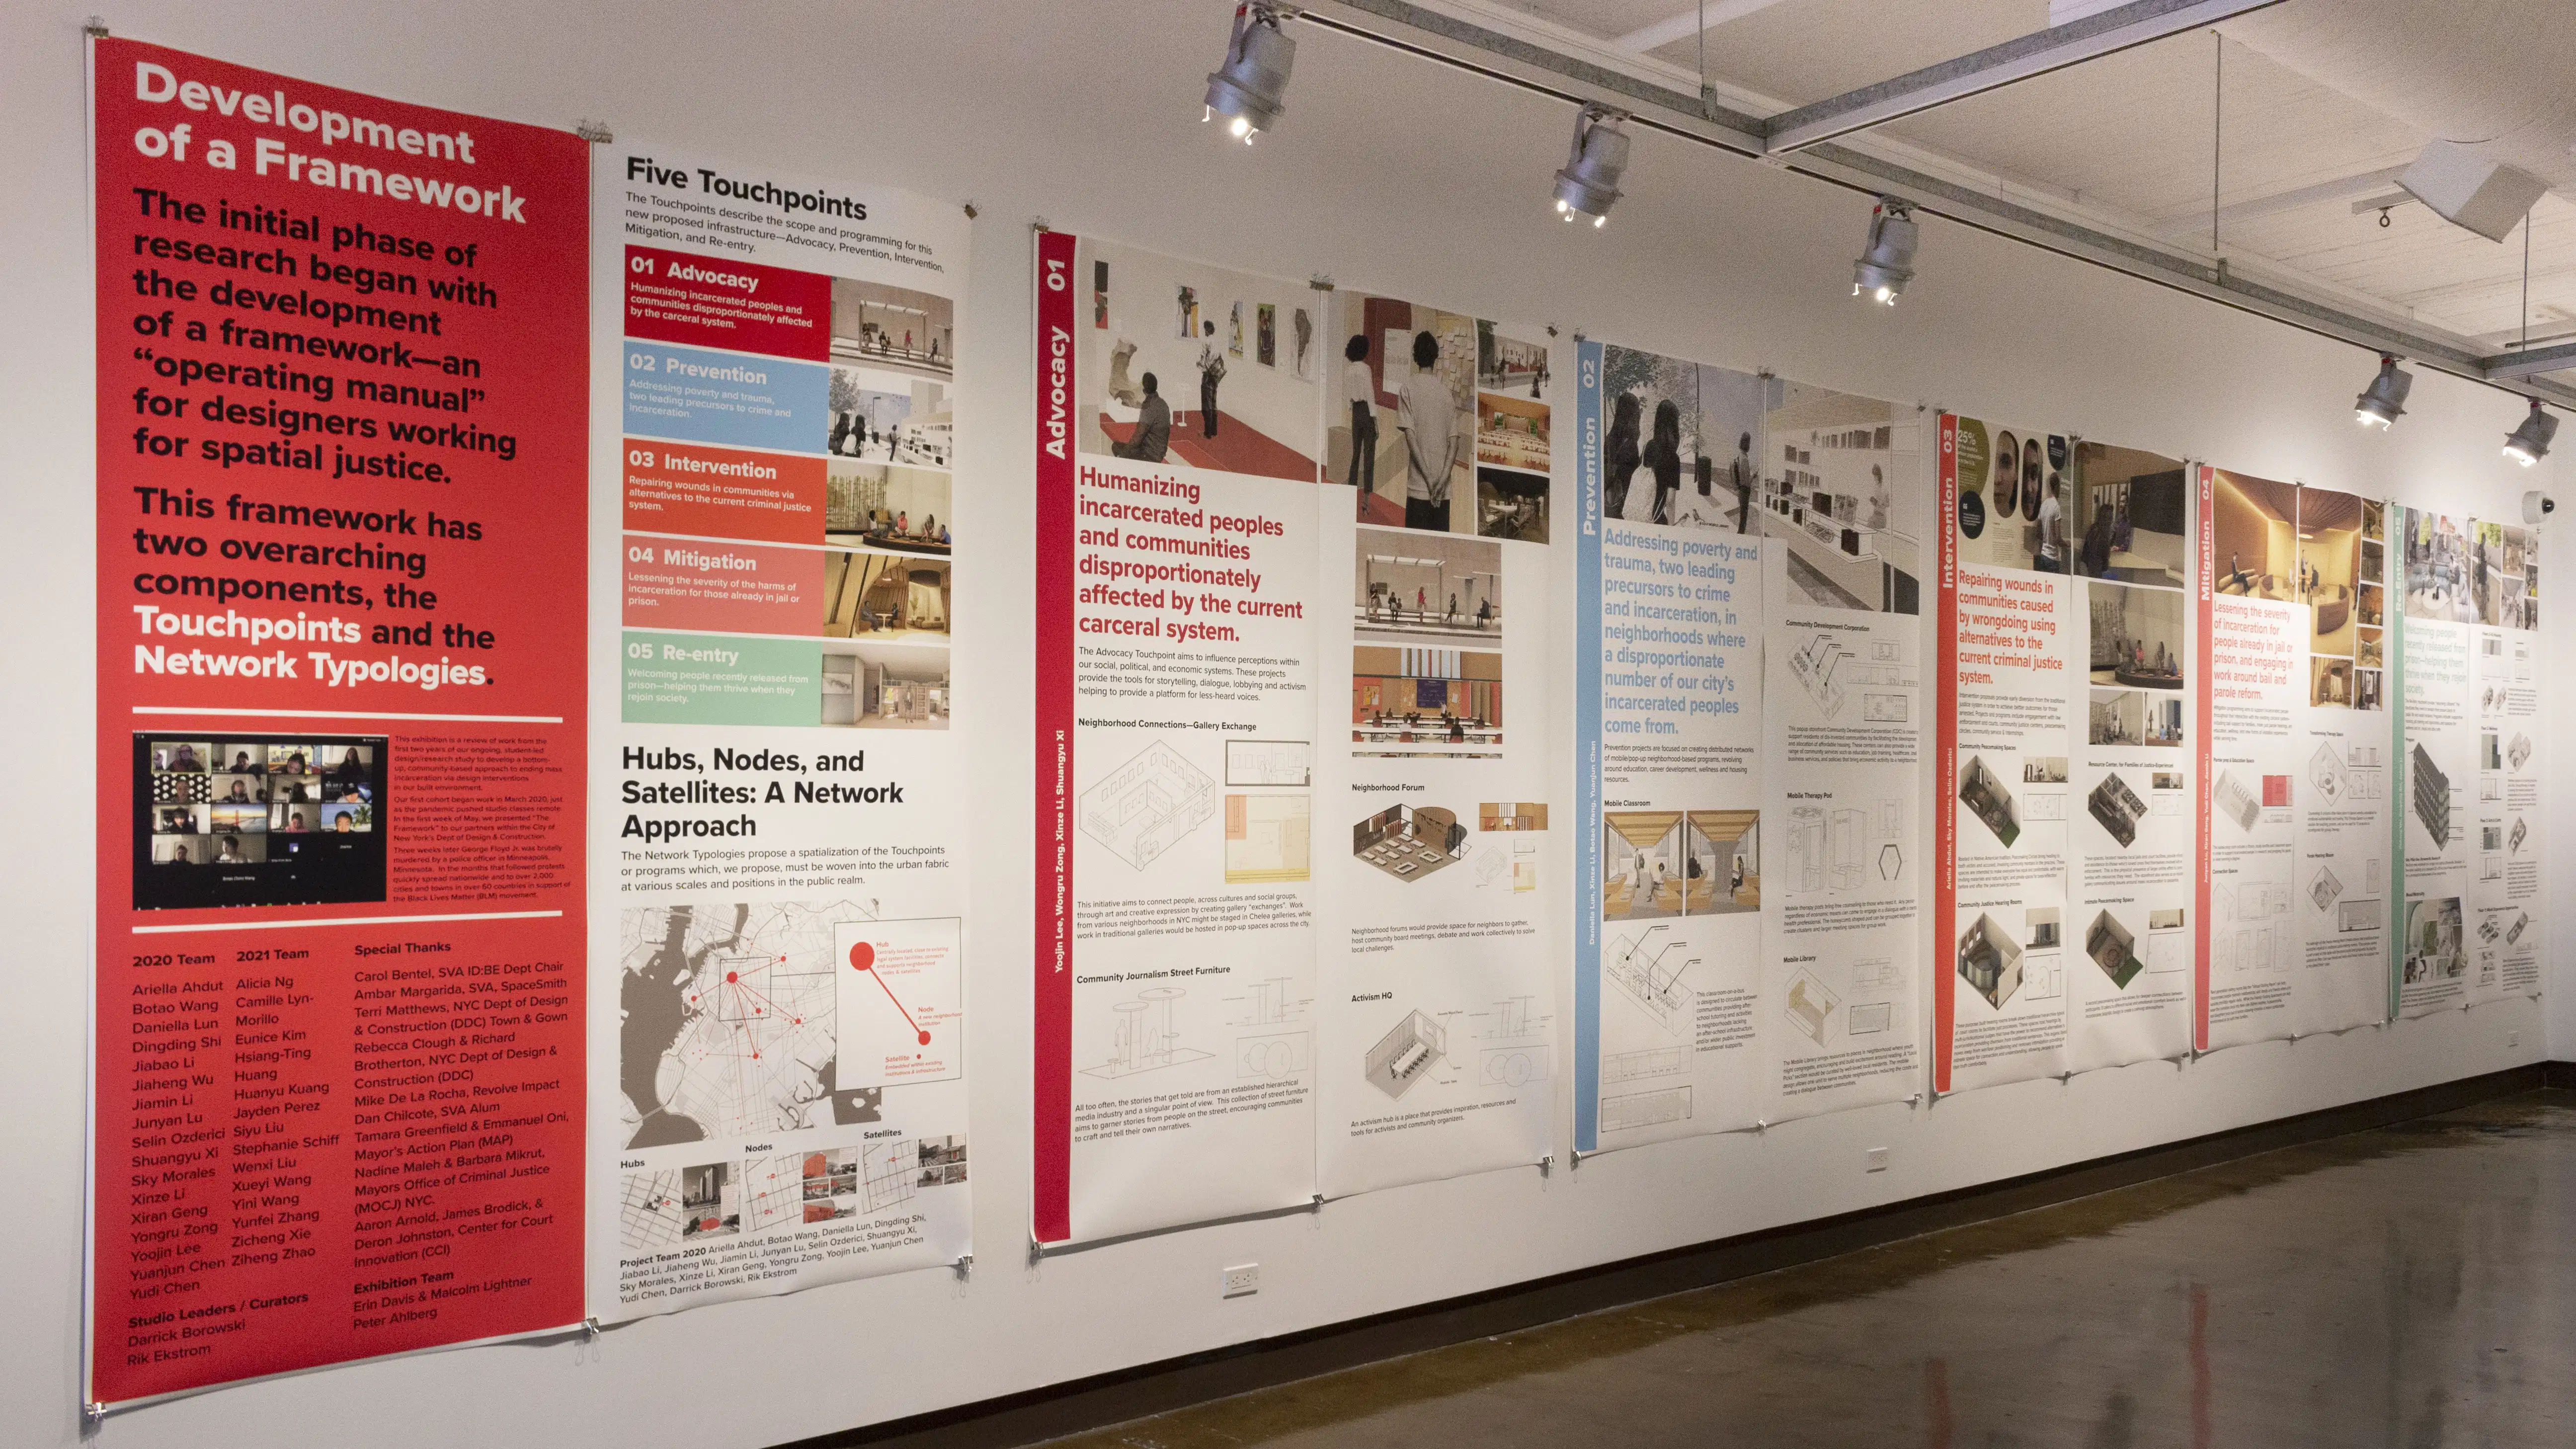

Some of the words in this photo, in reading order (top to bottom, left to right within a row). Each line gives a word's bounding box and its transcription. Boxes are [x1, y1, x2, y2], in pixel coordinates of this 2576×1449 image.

[136, 62, 475, 163] Development
[135, 123, 191, 161] of
[207, 140, 236, 170] a
[255, 137, 525, 223] Framework
[628, 156, 688, 188] Five
[698, 169, 867, 220] Touchpoints
[133, 187, 206, 224] The
[220, 199, 319, 242] initial
[333, 223, 434, 260] phase
[445, 243, 477, 268] of
[135, 235, 296, 276] research
[311, 253, 416, 295] began
[428, 276, 496, 308] with
[631, 256, 653, 274] 01
[667, 262, 758, 293] Advocacy
[1047, 258, 1065, 291] 01
[133, 269, 197, 300] the
[210, 280, 441, 336] development
[133, 311, 173, 337] of
[186, 321, 206, 341] a
[630, 354, 655, 371] 02
[667, 358, 766, 385] Prevention
[1584, 359, 1595, 388] 02
[1046, 325, 1070, 460] Advocacy
[133, 388, 189, 417] for
[202, 396, 377, 438] designers
[389, 421, 516, 461] working
[133, 427, 189, 457] for
[202, 439, 322, 470] spatial
[333, 445, 451, 483] justice.
[1944, 429, 1952, 453] 03
[630, 450, 654, 467] 03
[665, 454, 776, 479] Intervention
[1583, 417, 1596, 536] Prevention
[1080, 466, 1200, 504] Humanizing
[2202, 480, 2209, 500] 04
[134, 487, 214, 518] This
[227, 494, 416, 535] framework
[428, 512, 482, 541] has
[1080, 494, 1203, 528] incarcerated
[1210, 515, 1283, 538] peoples
[1080, 528, 1118, 547] and
[1126, 534, 1250, 560] communities
[1605, 529, 1678, 556] Addressing
[1683, 542, 1732, 562] poverty
[1735, 546, 1757, 561] and
[1943, 478, 1953, 588] Intervention
[133, 529, 207, 557] two
[221, 540, 425, 579] overarching
[629, 547, 653, 563] 04
[664, 550, 756, 571] Mitigation
[2201, 521, 2211, 600] Mitigation
[1079, 554, 1261, 592] disproportionately
[1605, 553, 1655, 574] trauma,
[1659, 560, 1684, 575] two
[1688, 561, 1735, 584] leading
[1959, 569, 2002, 592] Repairing
[2005, 579, 2042, 593] wounds
[2045, 580, 2053, 594] in
[134, 573, 373, 610] components,
[384, 583, 437, 610] the
[1079, 584, 1164, 608] affected
[1172, 590, 1194, 615] by
[1201, 593, 1231, 613] the
[1237, 600, 1302, 619] current
[1606, 579, 1674, 597] precursors
[1678, 583, 1691, 599] to
[1695, 584, 1731, 602] crime
[1959, 593, 2017, 609] communities
[2020, 600, 2053, 612] caused
[1606, 601, 1629, 616] and
[1634, 601, 1721, 626] incarceration,
[1725, 608, 1737, 625] in
[1959, 609, 1970, 627] by
[1972, 615, 2027, 633] wrongdoing
[2031, 618, 2055, 635] using
[2214, 600, 2248, 619] Lessening
[2250, 606, 2262, 617] the
[2264, 609, 2290, 622] severity
[134, 605, 361, 645] Touchpoints
[372, 621, 431, 646] and
[442, 623, 495, 649] the
[1079, 617, 1159, 636] carceral
[1167, 622, 1239, 643] system.
[1606, 623, 1703, 644] neighborhoods
[1707, 631, 1746, 648] where
[1959, 630, 2012, 647] alternatives
[2015, 636, 2024, 648] to
[2027, 636, 2042, 649] the
[2214, 617, 2222, 629] of
[2223, 618, 2267, 634] incarceration
[2270, 624, 2279, 635] for
[135, 645, 297, 678] Network
[308, 652, 494, 690] Typologies.
[628, 643, 653, 659] 05
[664, 644, 738, 666] Re-entry
[1605, 650, 1612, 661] a
[1617, 647, 1725, 669] disproportionate
[1959, 652, 1991, 665] current
[1994, 652, 2030, 667] criminal
[2033, 655, 2062, 671] justice
[1606, 671, 1656, 687] number
[1661, 673, 1674, 688] of
[1677, 677, 1698, 689] our
[1959, 671, 1993, 686] system.
[1606, 692, 1686, 712] incarcerated
[1690, 698, 1739, 717] peoples
[1079, 719, 1136, 728] Neighborhood
[1222, 723, 1256, 731] Exchange
[1605, 721, 1641, 733] come
[1645, 718, 1679, 734] from.
[623, 746, 704, 773] Hubs,
[715, 748, 806, 774] Nodes,
[816, 750, 864, 771] and
[622, 779, 755, 804] Satellites:
[765, 781, 785, 803] A
[795, 782, 902, 803] Network
[1353, 784, 1399, 793] Neighborhood
[621, 814, 755, 843] Approach
[133, 955, 172, 966] 2020
[177, 954, 215, 964] Team
[237, 950, 269, 962] 2021
[274, 949, 309, 959] Team
[355, 944, 401, 957] Special
[405, 942, 451, 953] Thanks
[1077, 973, 1124, 983] Community
[1126, 970, 1168, 980] Journalism
[864, 1129, 901, 1139] Satellites
[745, 1144, 772, 1153] Nodes
[621, 1160, 644, 1169] Hubs
[620, 1256, 653, 1268] Project
[656, 1253, 680, 1262] Team
[683, 1247, 706, 1258] 2020
